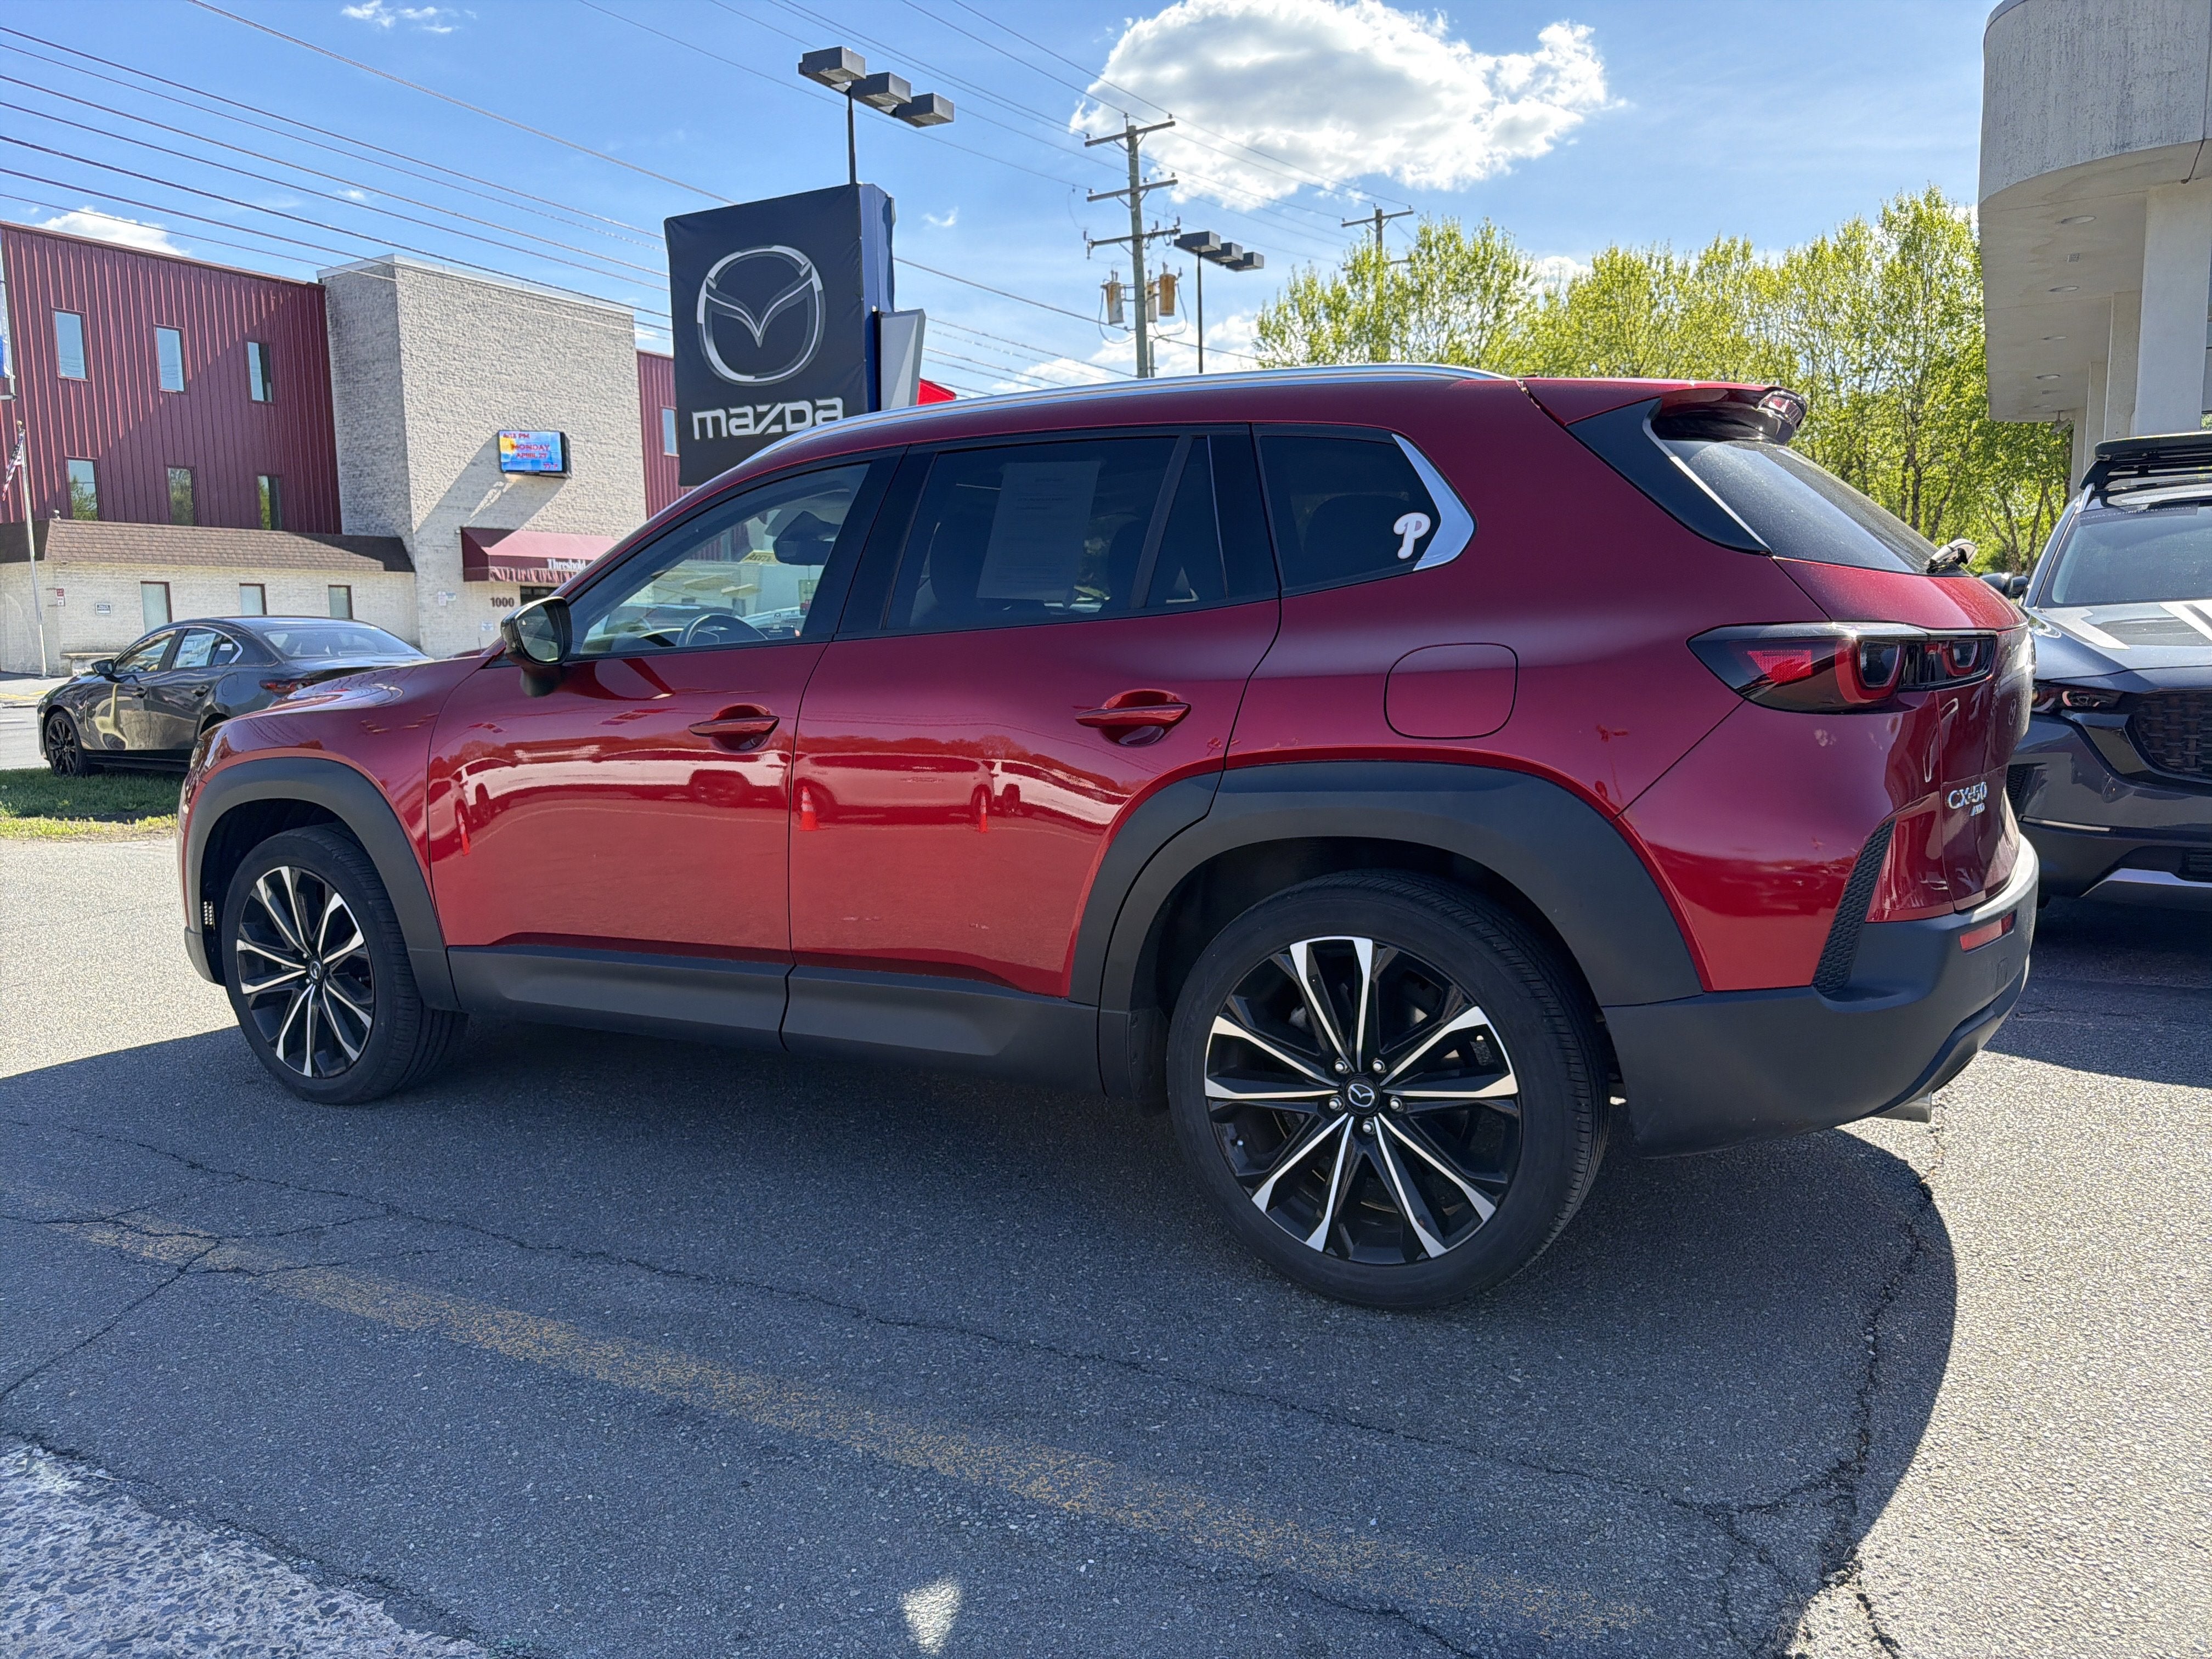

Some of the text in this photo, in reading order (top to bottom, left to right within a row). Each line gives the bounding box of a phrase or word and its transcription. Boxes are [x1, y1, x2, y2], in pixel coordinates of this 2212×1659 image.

[546, 558, 586, 571] Threshold
[490, 597, 515, 608] 1000
[1948, 782, 1987, 809] CX-50
